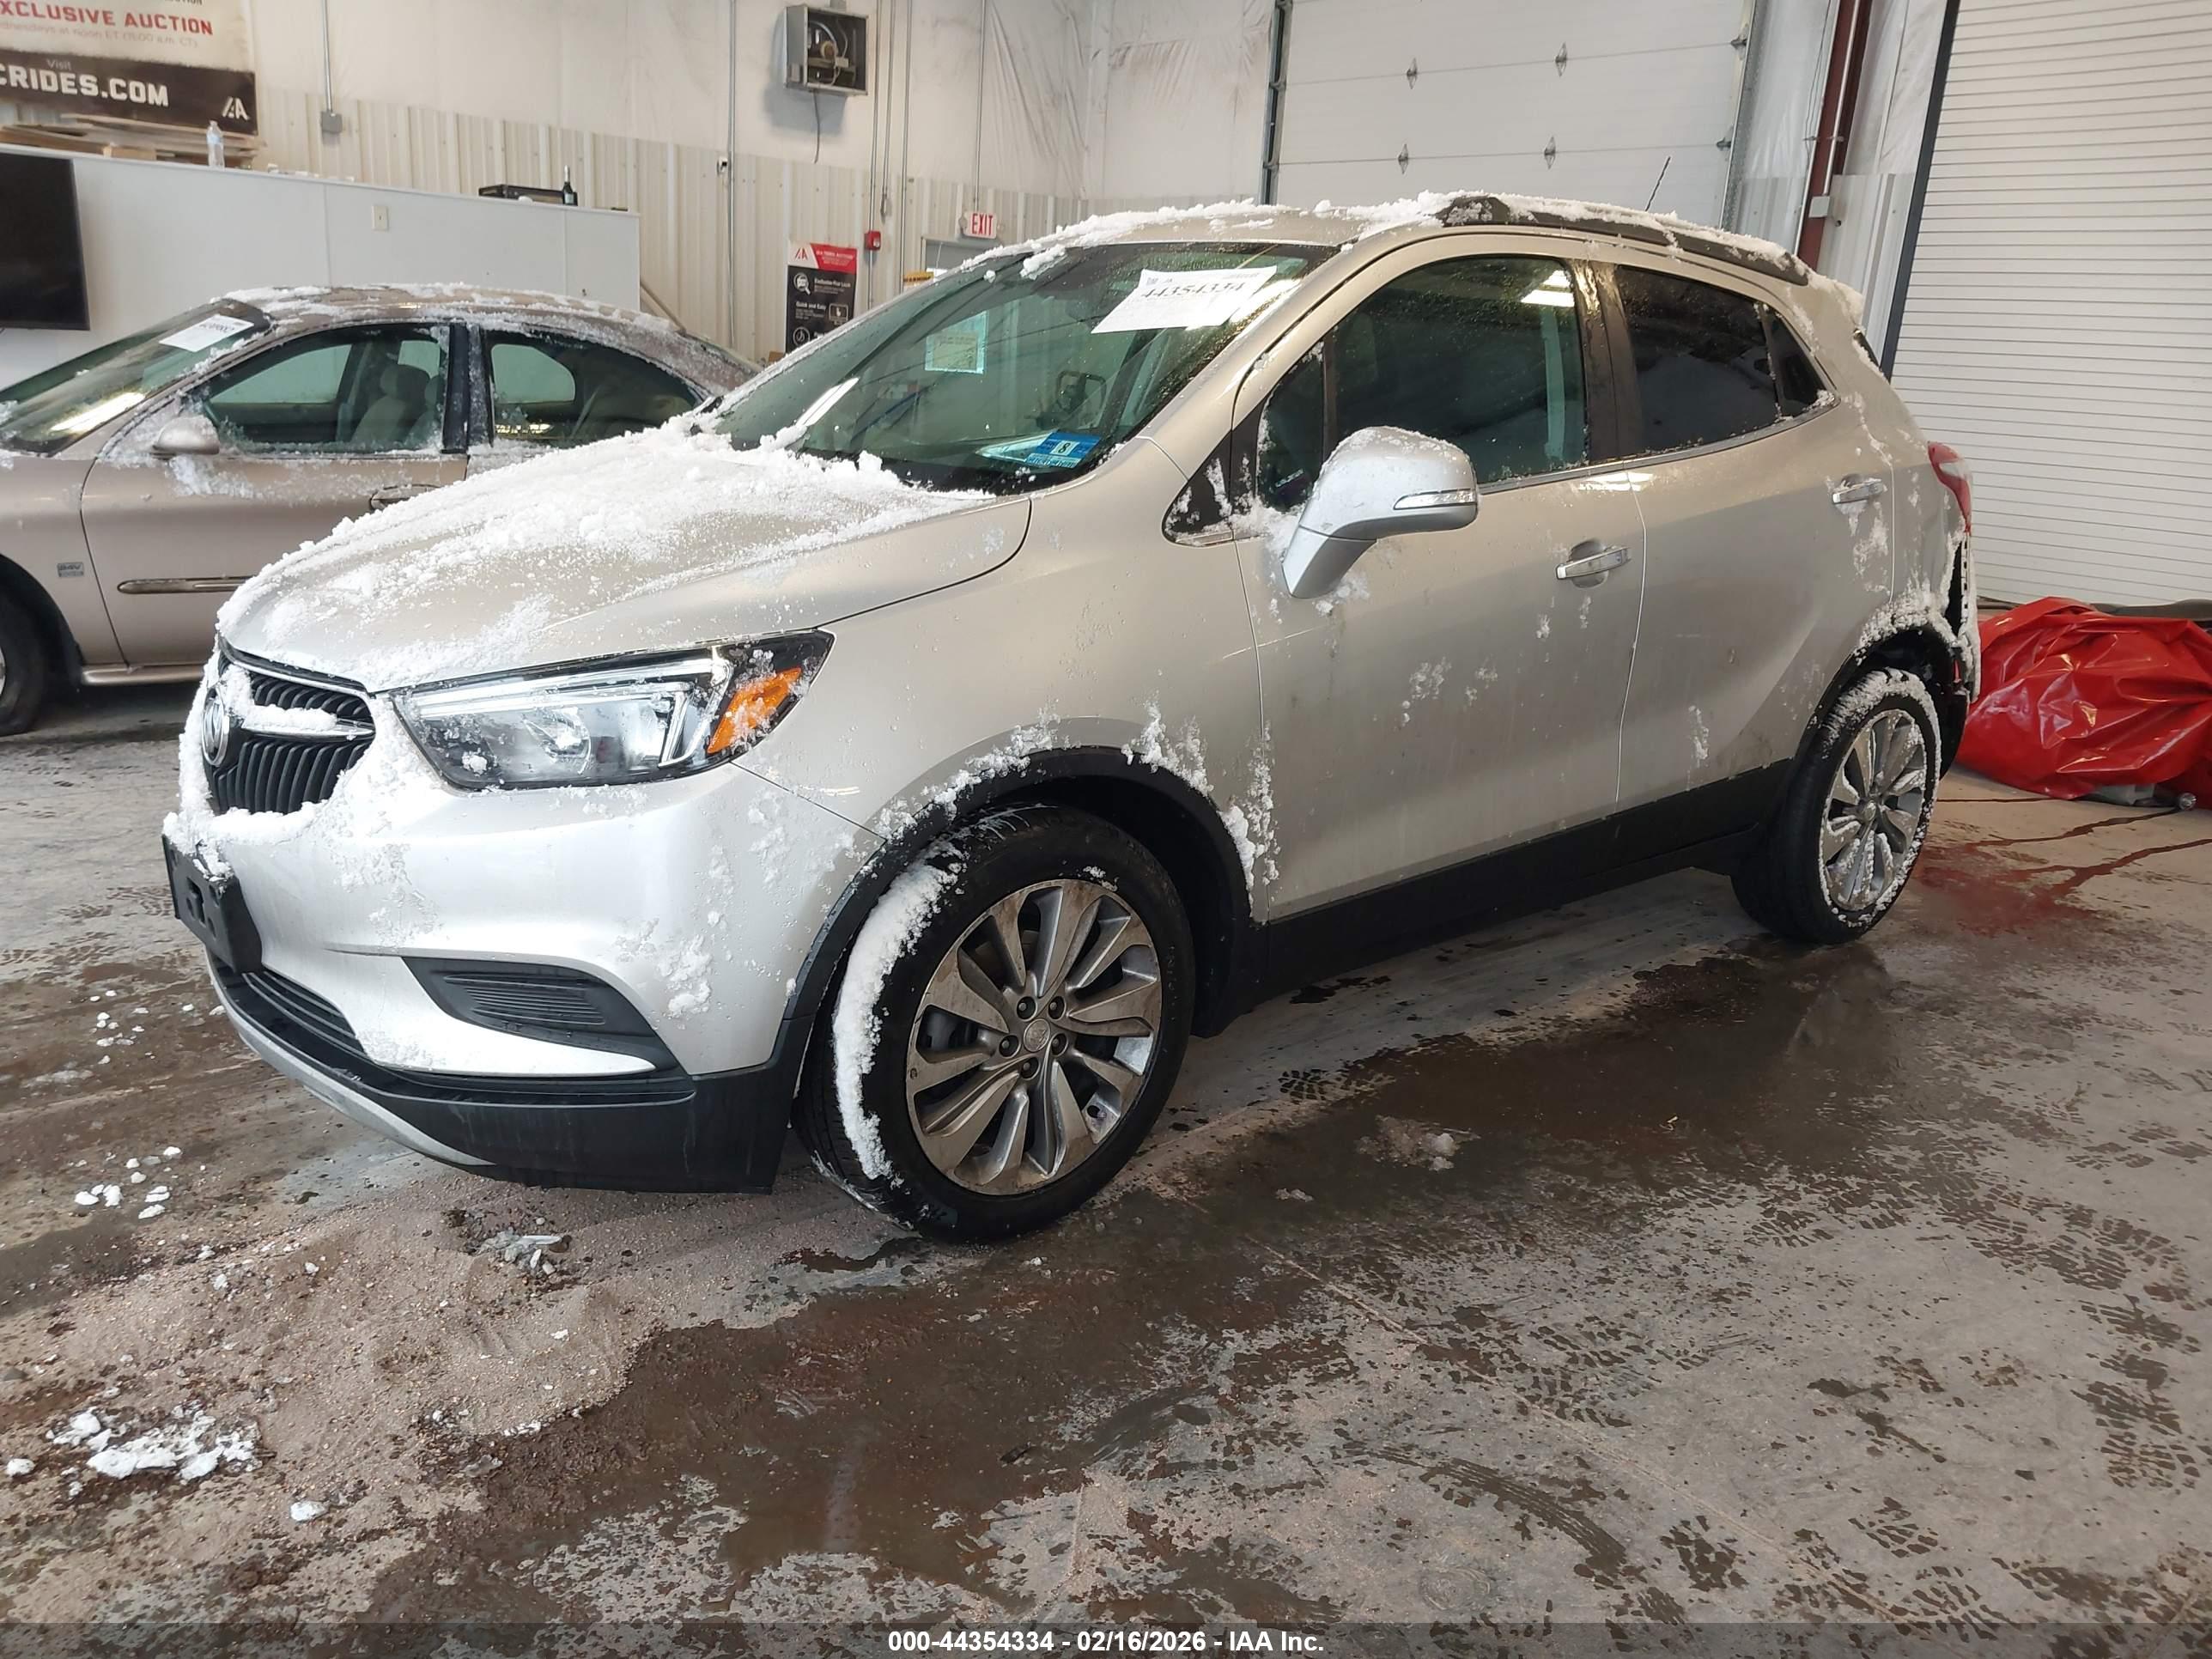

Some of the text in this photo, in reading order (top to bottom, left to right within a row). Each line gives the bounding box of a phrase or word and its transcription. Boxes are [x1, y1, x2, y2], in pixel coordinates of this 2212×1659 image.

[0, 1, 213, 35] XCLUSIVE AUCTION
[46, 58, 71, 70] Visit
[971, 212, 994, 236] EXIT
[1057, 442, 1071, 454] 8
